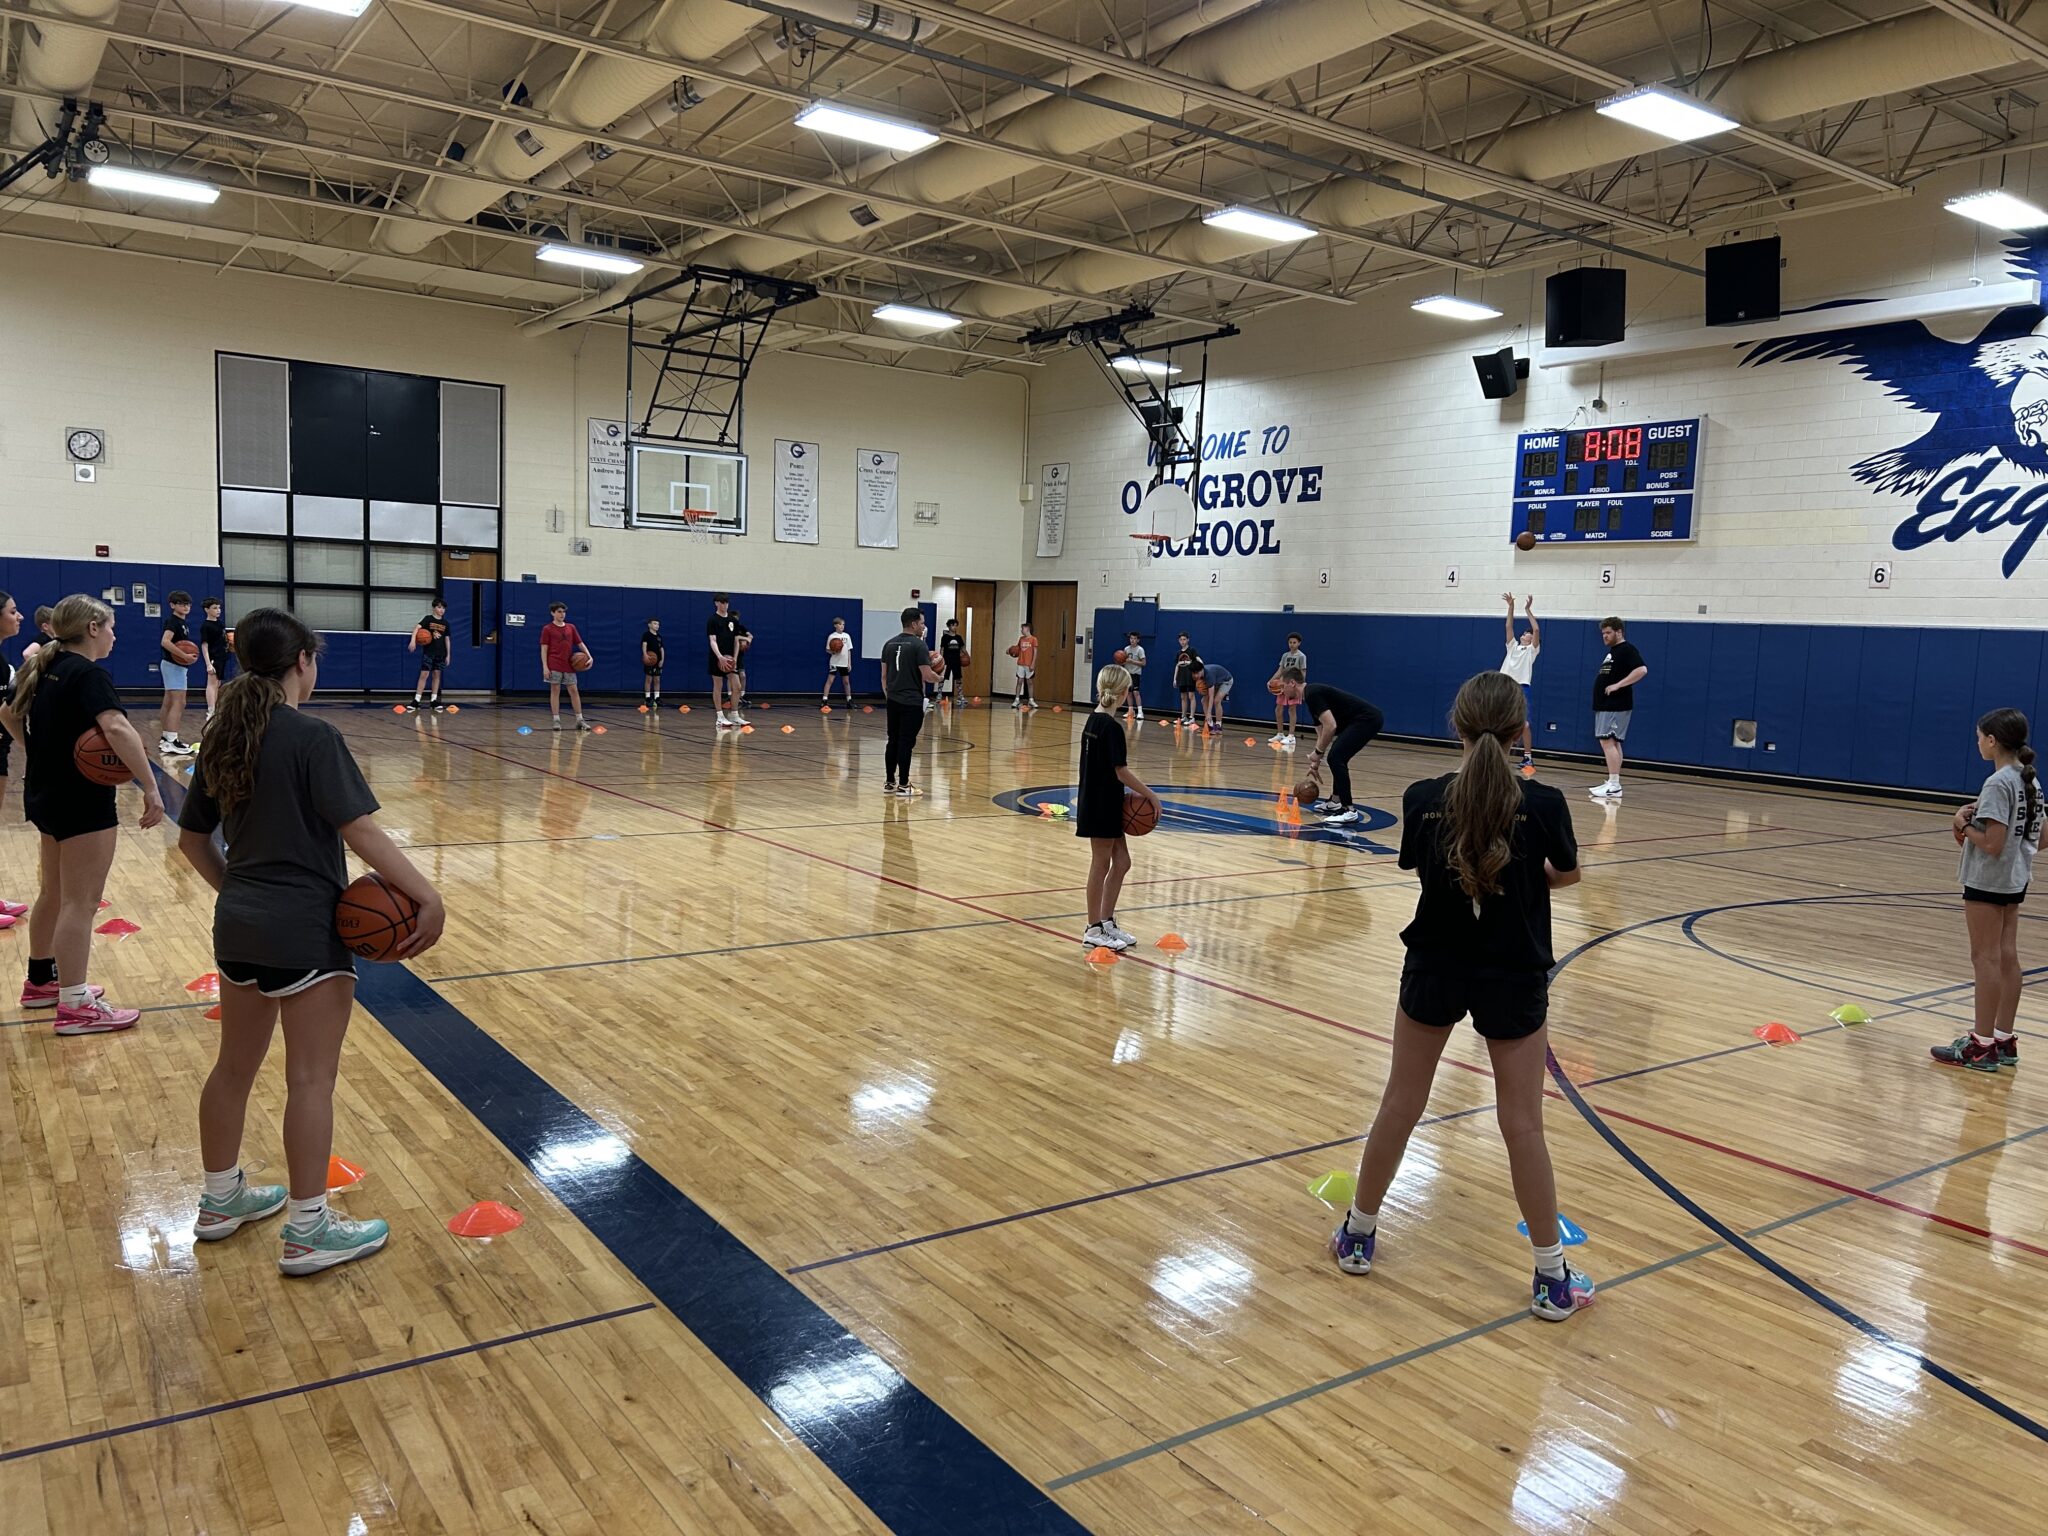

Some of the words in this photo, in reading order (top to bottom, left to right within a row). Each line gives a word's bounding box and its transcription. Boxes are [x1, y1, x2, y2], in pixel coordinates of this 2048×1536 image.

[1648, 424, 1693, 440] GUEST
[1262, 424, 1290, 455] TO
[1524, 436, 1560, 450] HOME
[1584, 427, 1642, 462] 8:08
[1660, 471, 1678, 479] POSS
[1528, 479, 1545, 487] POSS
[1646, 481, 1670, 490] BONUS
[1199, 466, 1323, 511] GROVE
[1534, 488, 1556, 496] BONUS
[1589, 486, 1611, 494] PERIOD
[1528, 502, 1547, 510] FOULS
[1576, 500, 1600, 508] PLAYER
[1607, 499, 1624, 507] FOUL
[1653, 497, 1676, 505] FOULS
[1650, 530, 1673, 538] SCORE
[1102, 574, 1107, 583] 1
[1211, 573, 1217, 584] 2
[1321, 573, 1327, 584] 3
[1448, 571, 1456, 583] 4
[1602, 570, 1611, 584] 5
[1874, 567, 1885, 584] 6
